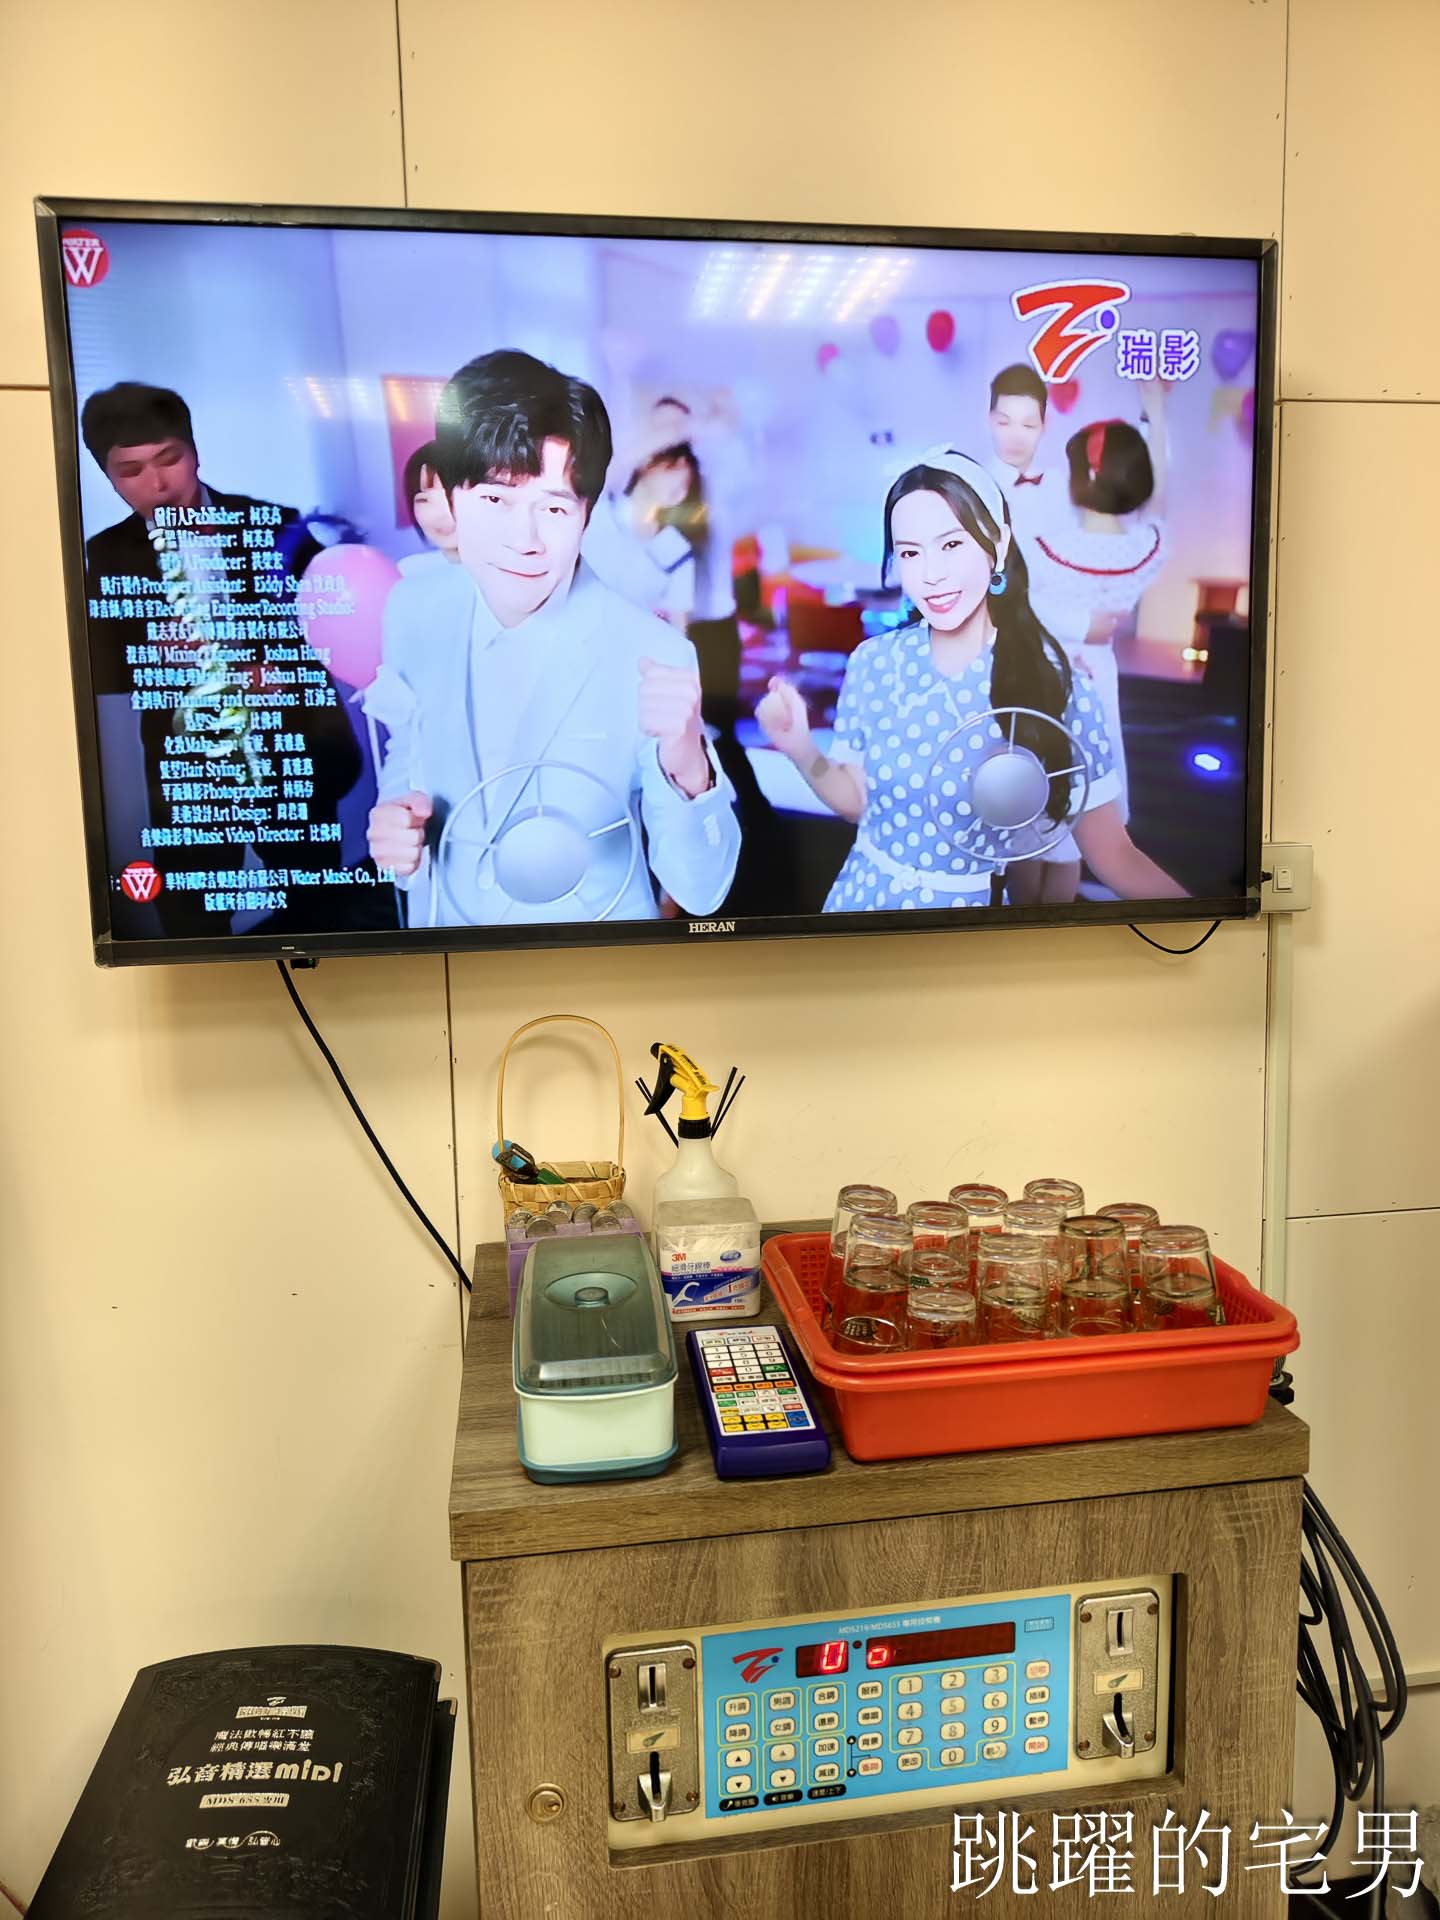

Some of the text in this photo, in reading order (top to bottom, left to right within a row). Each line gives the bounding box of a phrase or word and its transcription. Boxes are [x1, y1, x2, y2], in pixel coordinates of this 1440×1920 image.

[1119, 332, 1197, 378] 瑞影
[688, 921, 736, 934] HERAN
[671, 1252, 687, 1262] 3M
